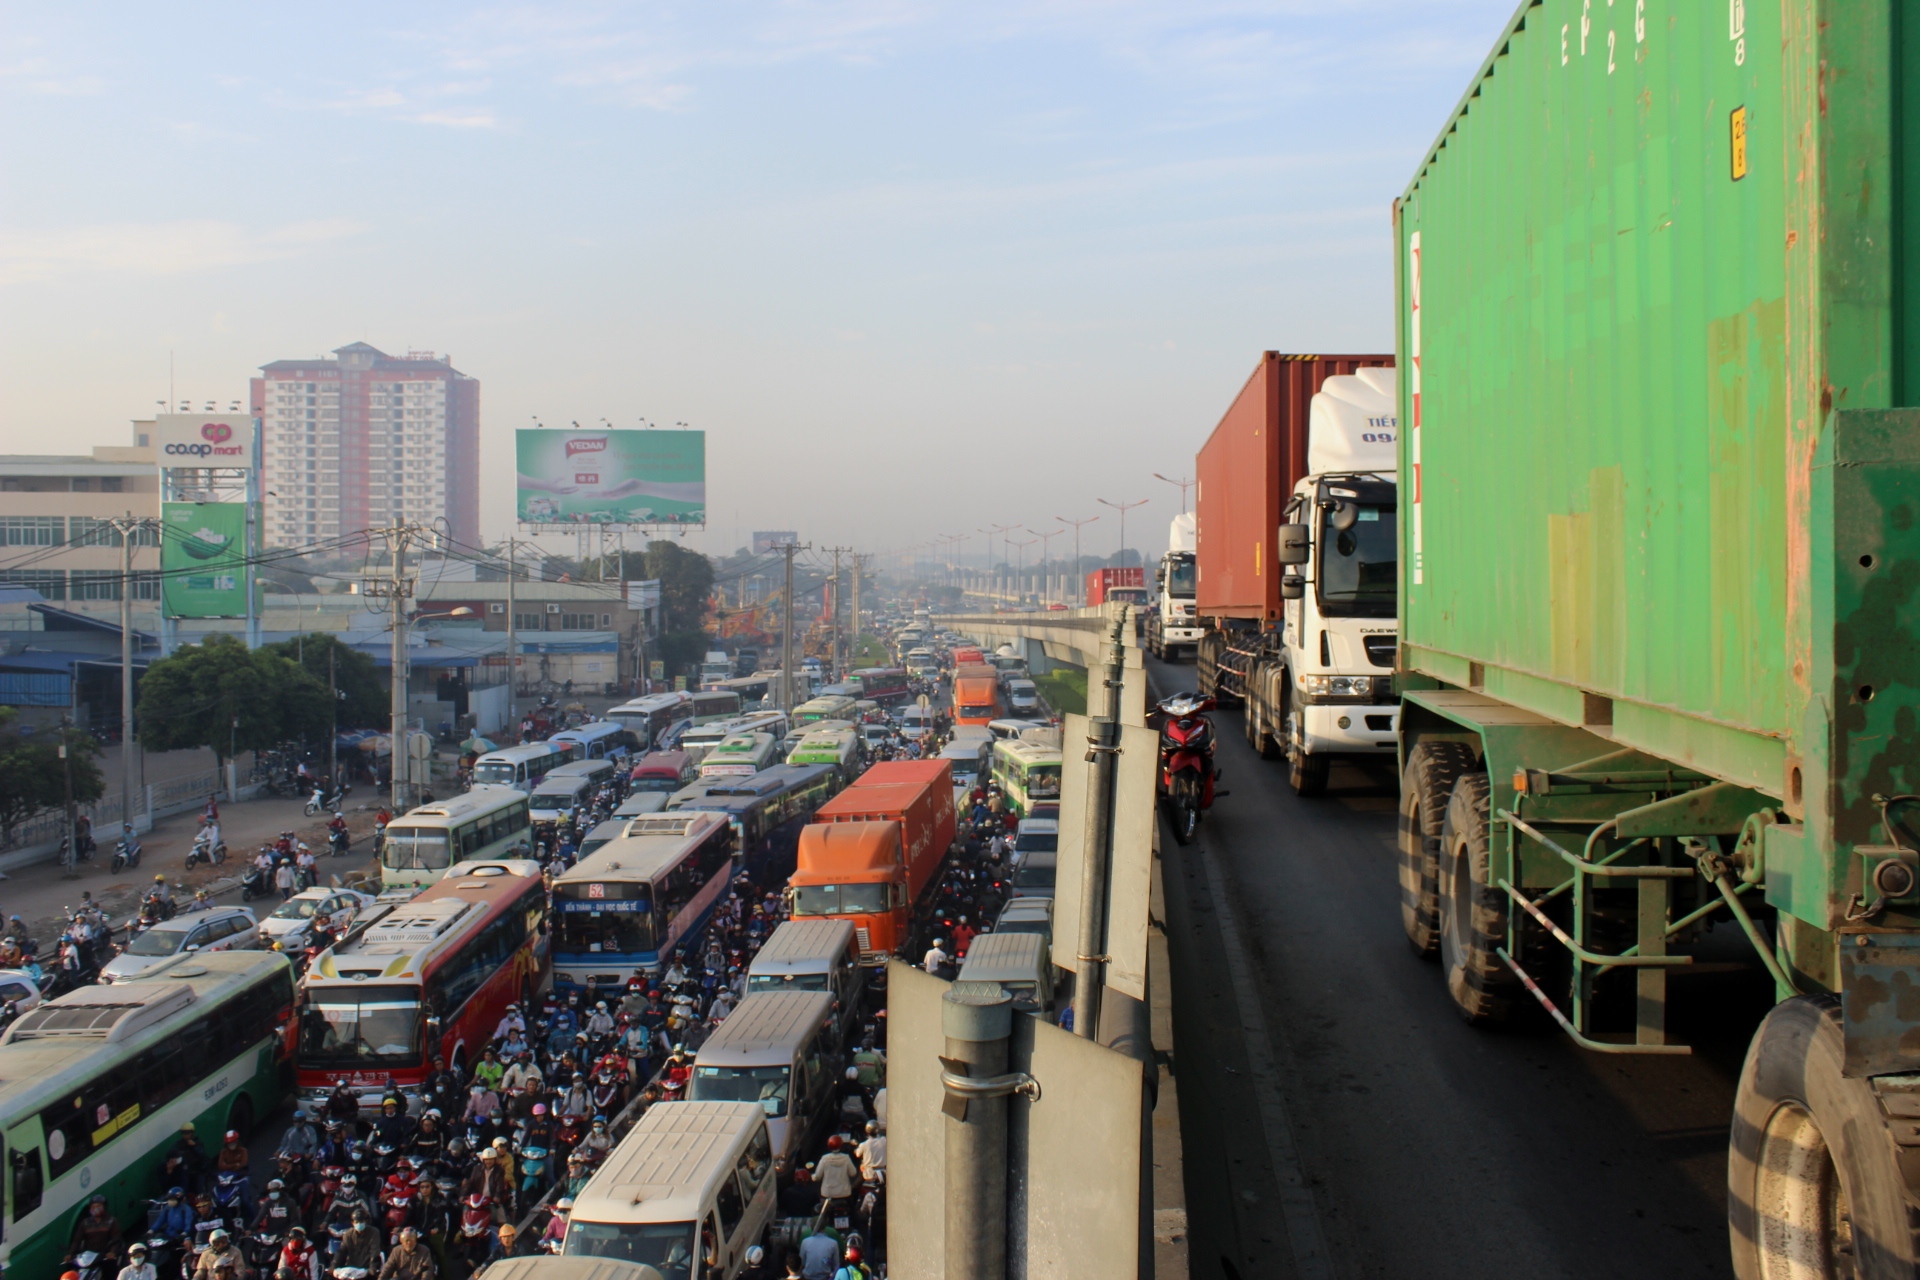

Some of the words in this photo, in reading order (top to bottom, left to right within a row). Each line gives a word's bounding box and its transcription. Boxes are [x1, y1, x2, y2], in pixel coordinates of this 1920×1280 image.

[1362, 433, 1397, 443] 09
[214, 445, 243, 455] mart
[569, 441, 604, 450] VEDAN
[591, 885, 602, 897] 52
